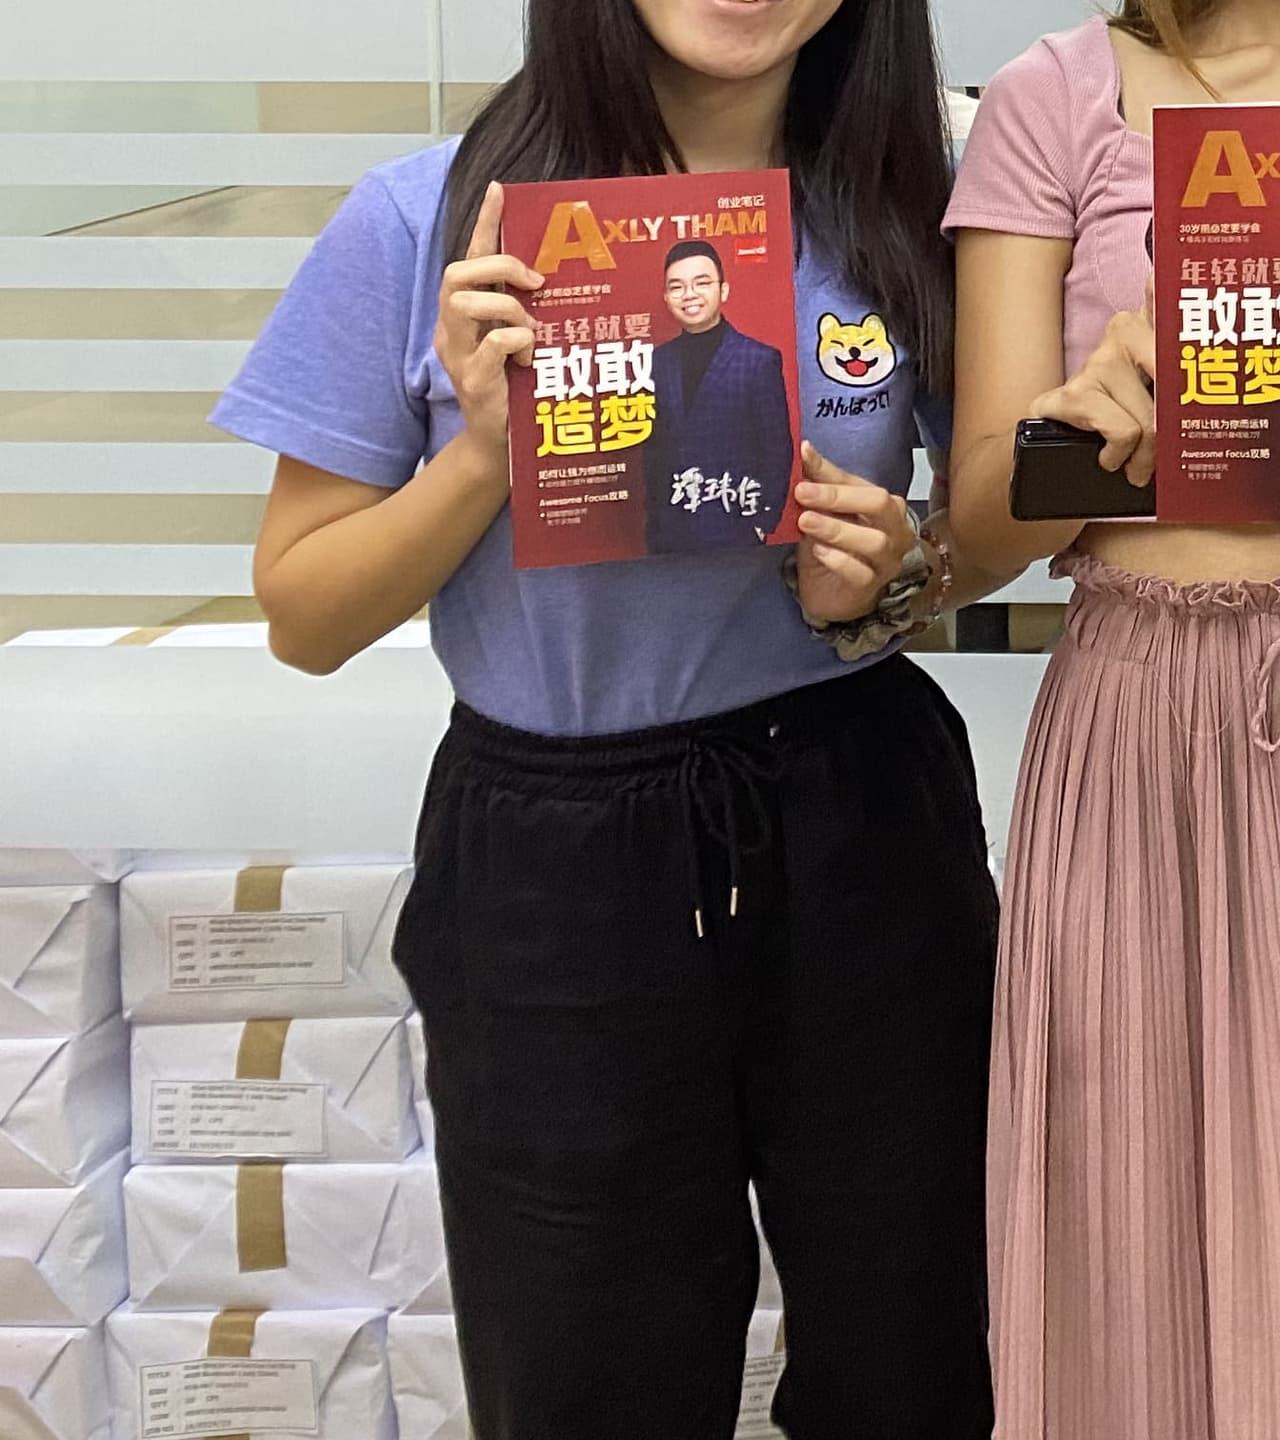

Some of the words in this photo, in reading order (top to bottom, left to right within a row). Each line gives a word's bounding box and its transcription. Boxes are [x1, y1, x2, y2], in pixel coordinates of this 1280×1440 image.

[533, 200, 665, 275] AXLY
[670, 209, 768, 240] THAM
[535, 312, 652, 346] 年轻就要
[532, 338, 656, 402] 敢敢
[535, 391, 657, 458] 造梦
[1180, 449, 1224, 459] Awesome
